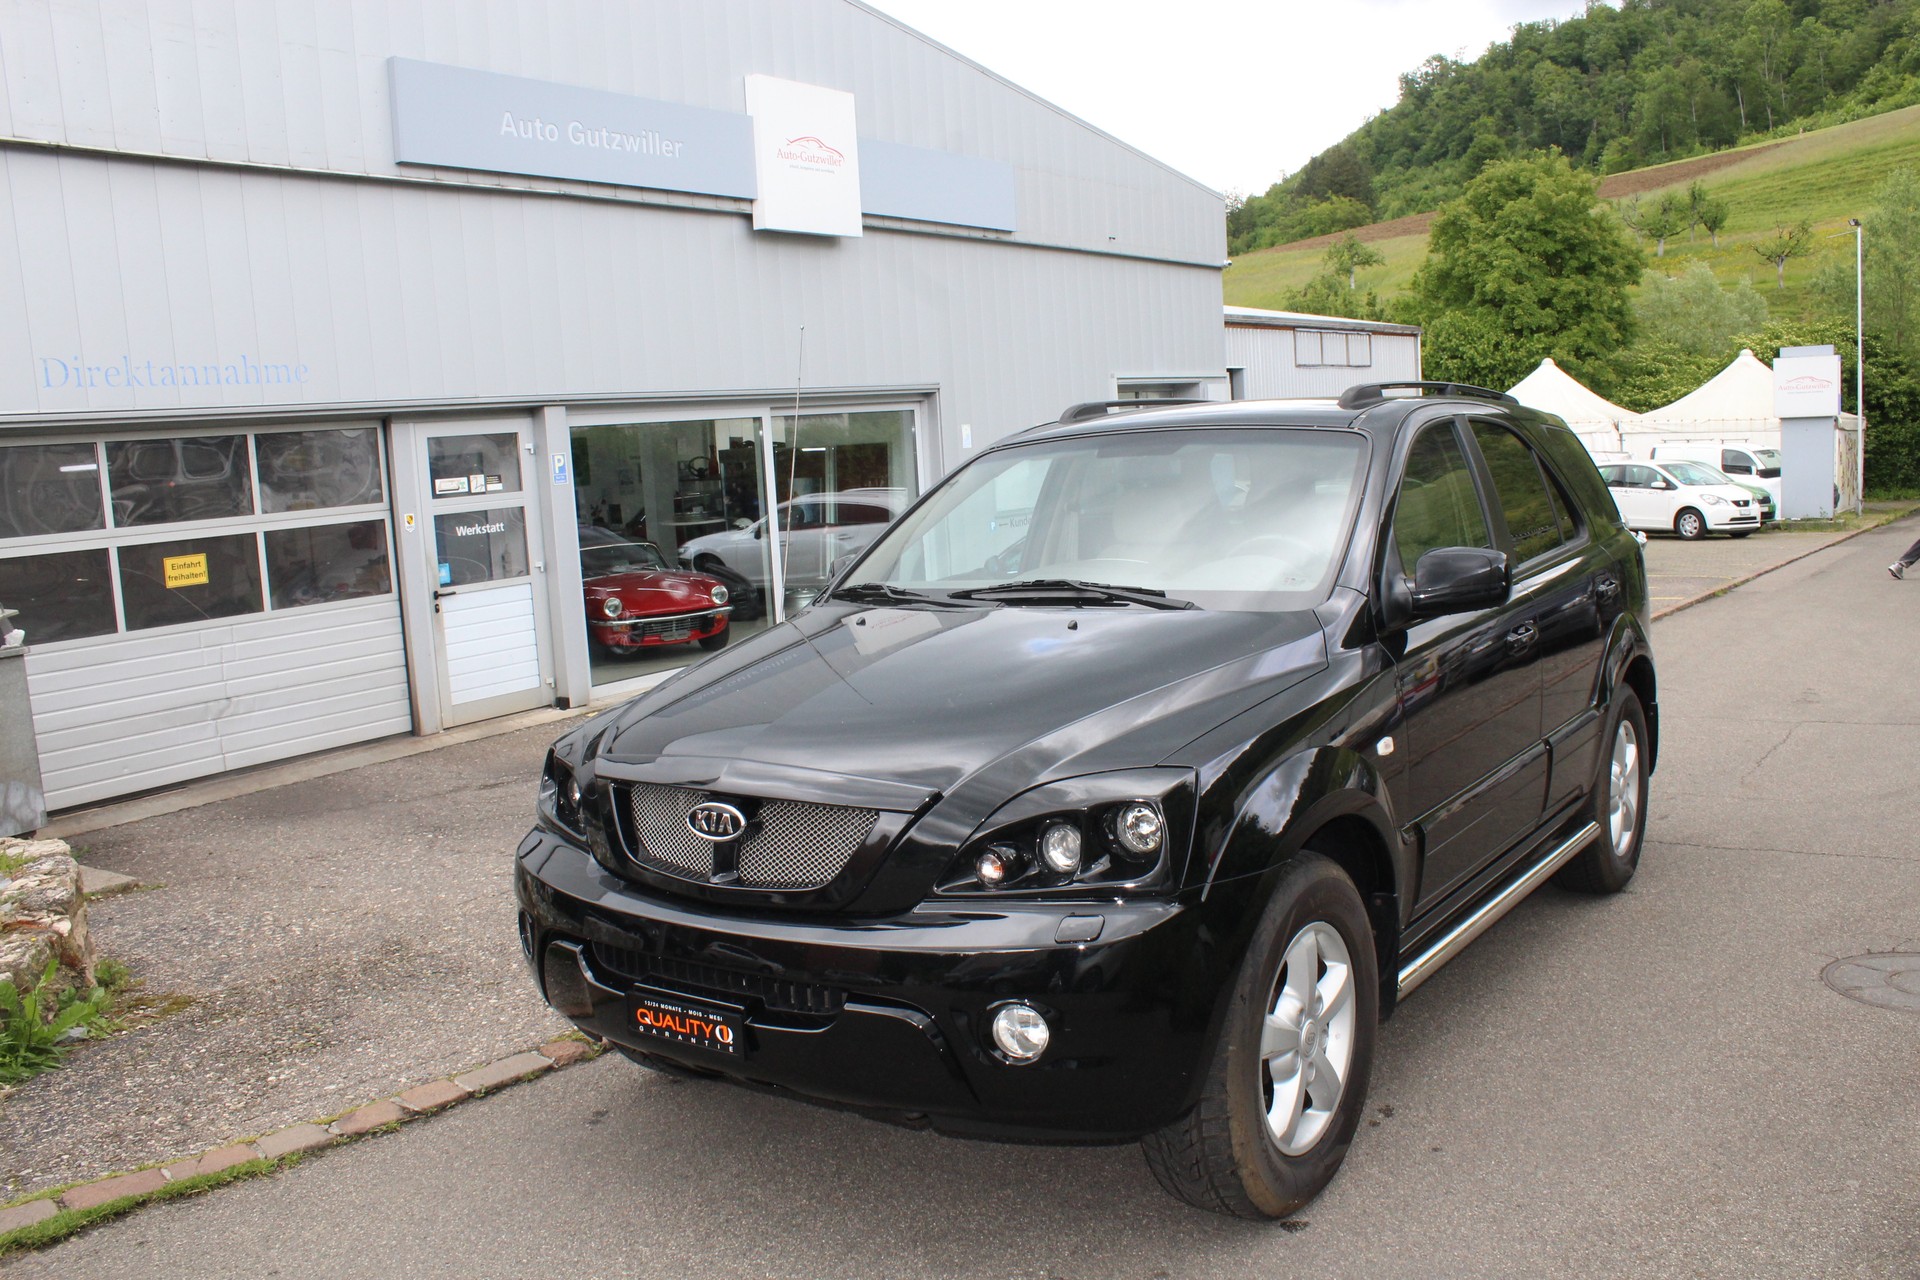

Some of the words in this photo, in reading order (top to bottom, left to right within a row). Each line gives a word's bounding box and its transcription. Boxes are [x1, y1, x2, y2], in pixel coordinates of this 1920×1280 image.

[500, 111, 559, 142] Auto
[568, 120, 683, 158] Gutzwiller
[777, 148, 842, 167] Auto-Gutzwiller
[39, 354, 309, 389] Direktannahme
[456, 522, 505, 536] Werkstatt
[171, 561, 201, 571] Einfahrt
[168, 571, 206, 582] freihalten!
[695, 810, 734, 834] KIA
[660, 1003, 682, 1013] MONATE
[688, 1009, 703, 1018] MOIS
[709, 1014, 723, 1022] MESI
[639, 1026, 734, 1053] GARANTIE
